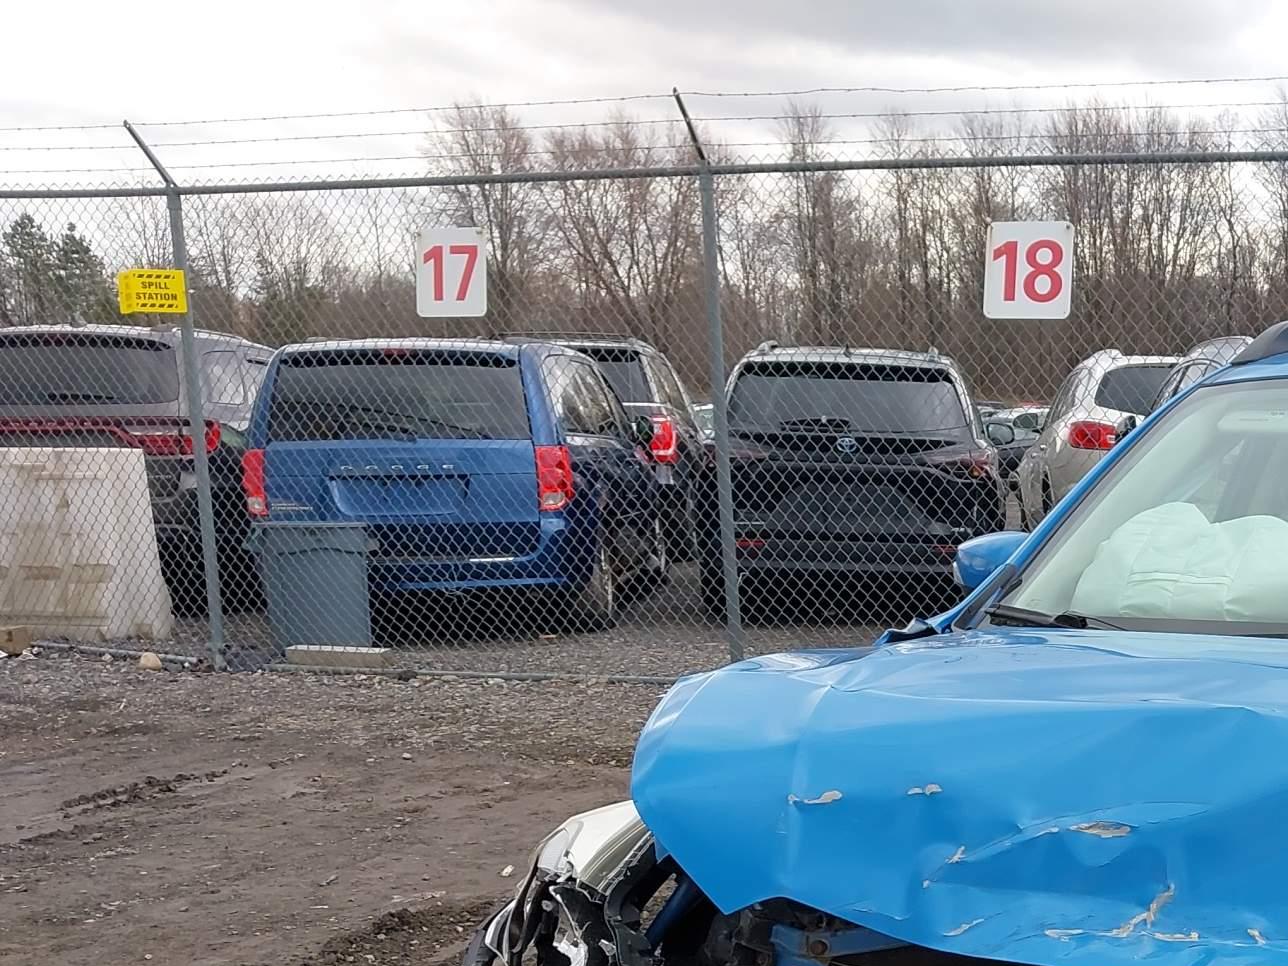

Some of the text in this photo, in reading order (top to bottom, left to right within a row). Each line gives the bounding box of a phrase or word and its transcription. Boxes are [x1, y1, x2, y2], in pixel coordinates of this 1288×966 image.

[140, 281, 170, 290] SPILL
[423, 245, 478, 301] 17
[992, 239, 1064, 303] 18
[135, 292, 178, 301] STATION
